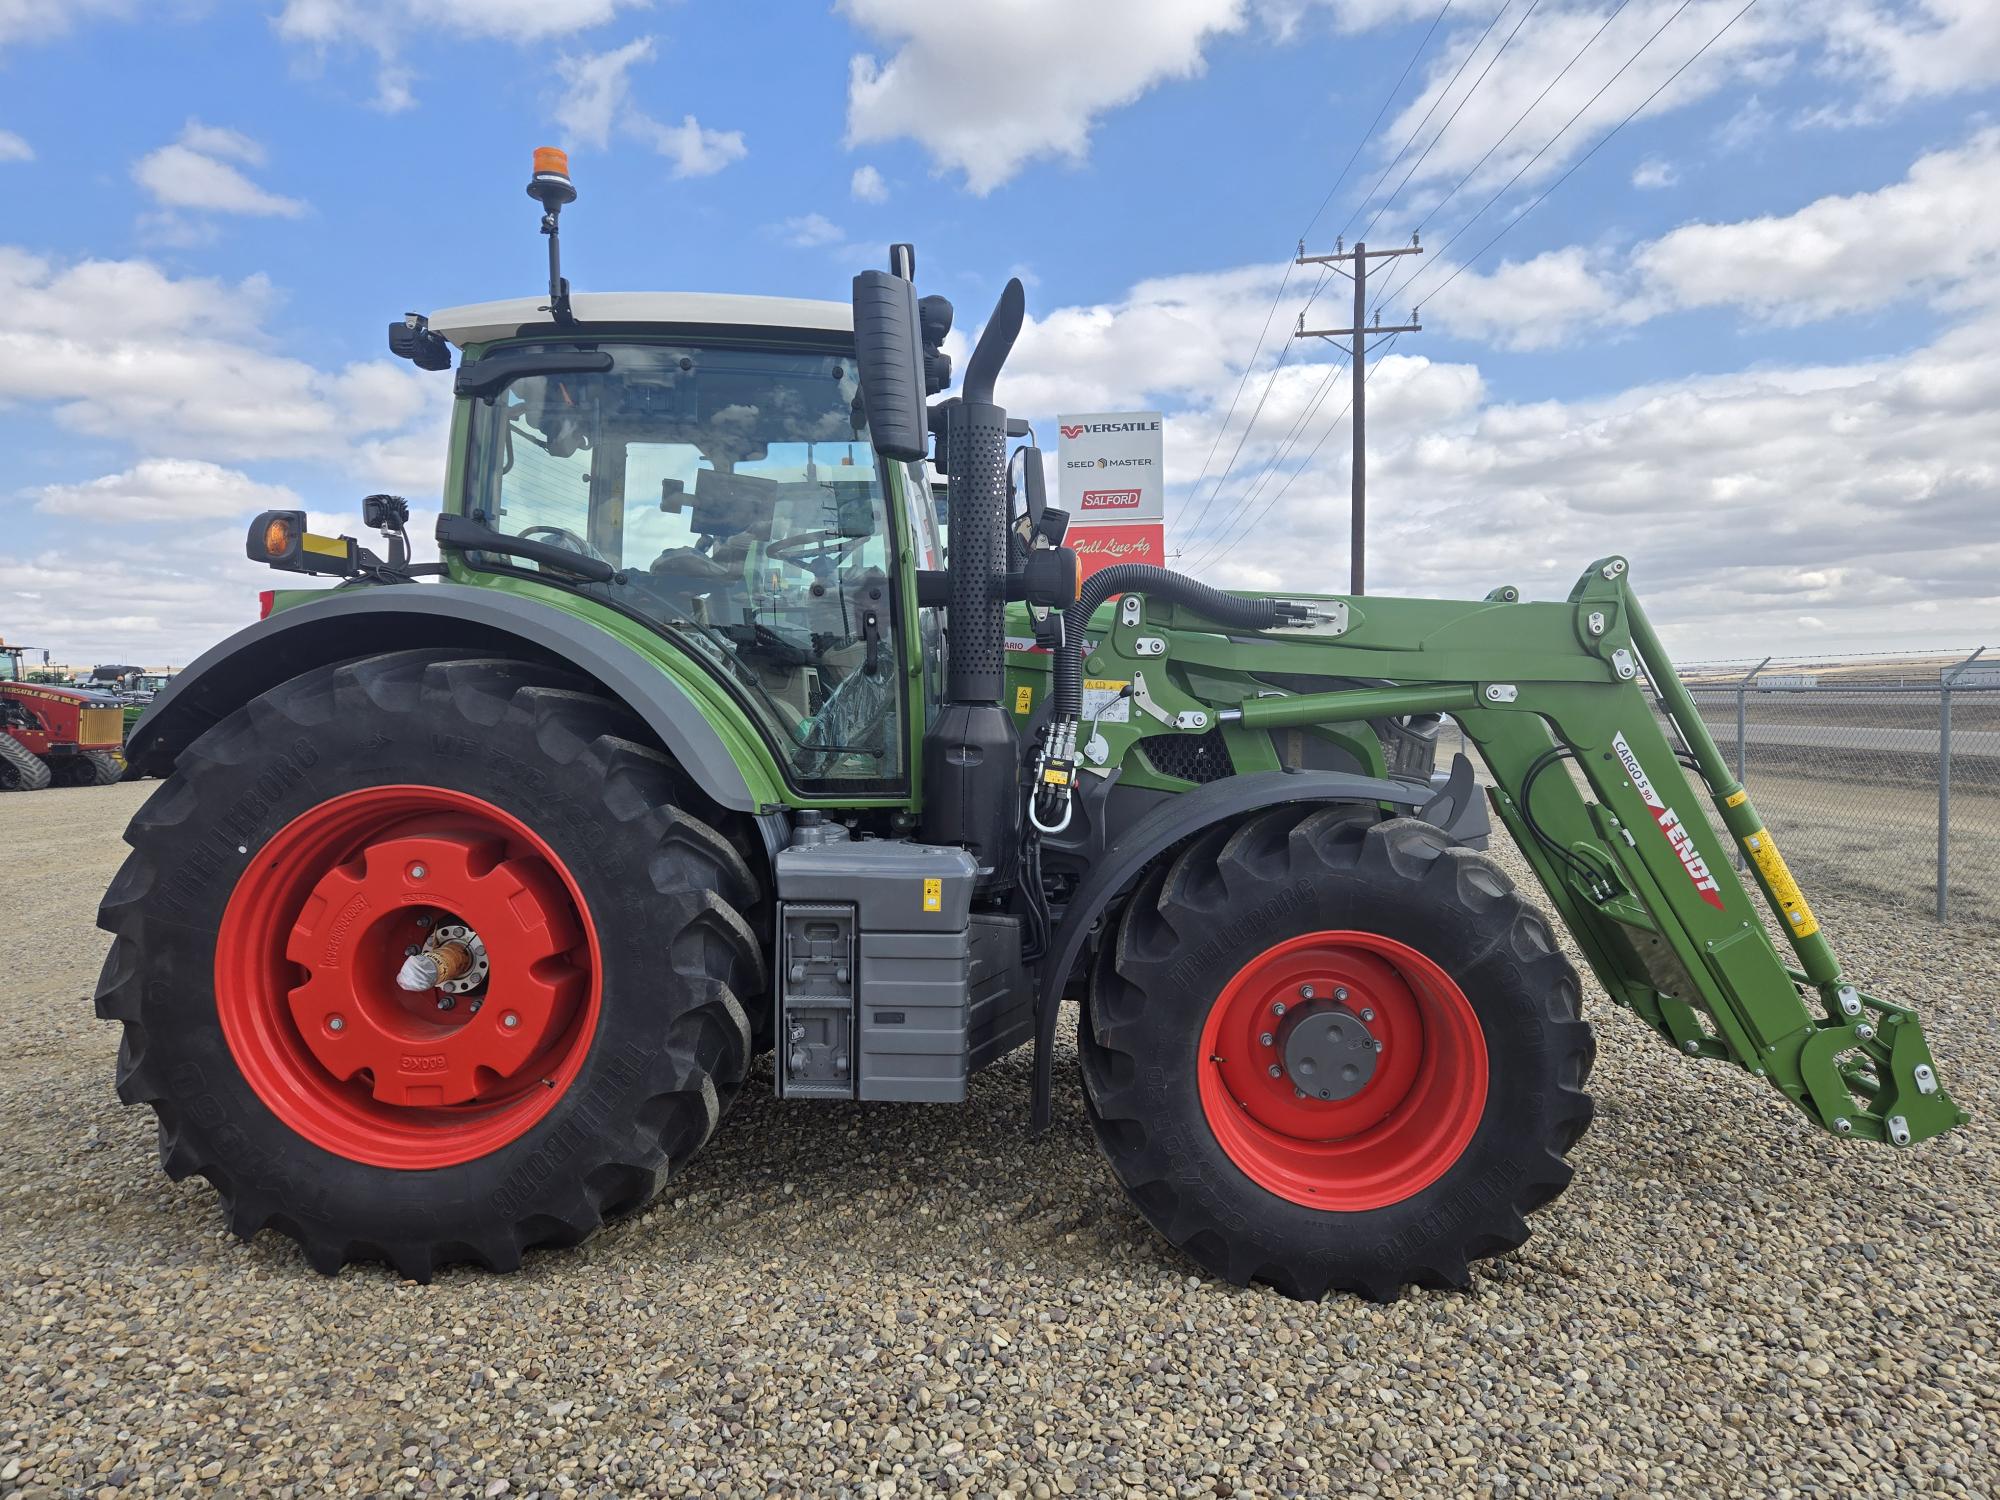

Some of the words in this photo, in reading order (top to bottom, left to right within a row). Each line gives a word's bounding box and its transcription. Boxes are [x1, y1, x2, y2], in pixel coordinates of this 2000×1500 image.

[1083, 421, 1160, 433] VERSATILE
[1109, 458, 1152, 467] MASTER
[1084, 492, 1138, 506] SALFORD
[1073, 539, 1100, 555] Full
[1101, 537, 1130, 557] Line
[1130, 536, 1151, 556] Ag
[1005, 641, 1024, 650] ARIO
[1615, 741, 1643, 781] CARGO
[157, 736, 320, 911] TRELLEBORG
[1657, 807, 1720, 891] FENDT
